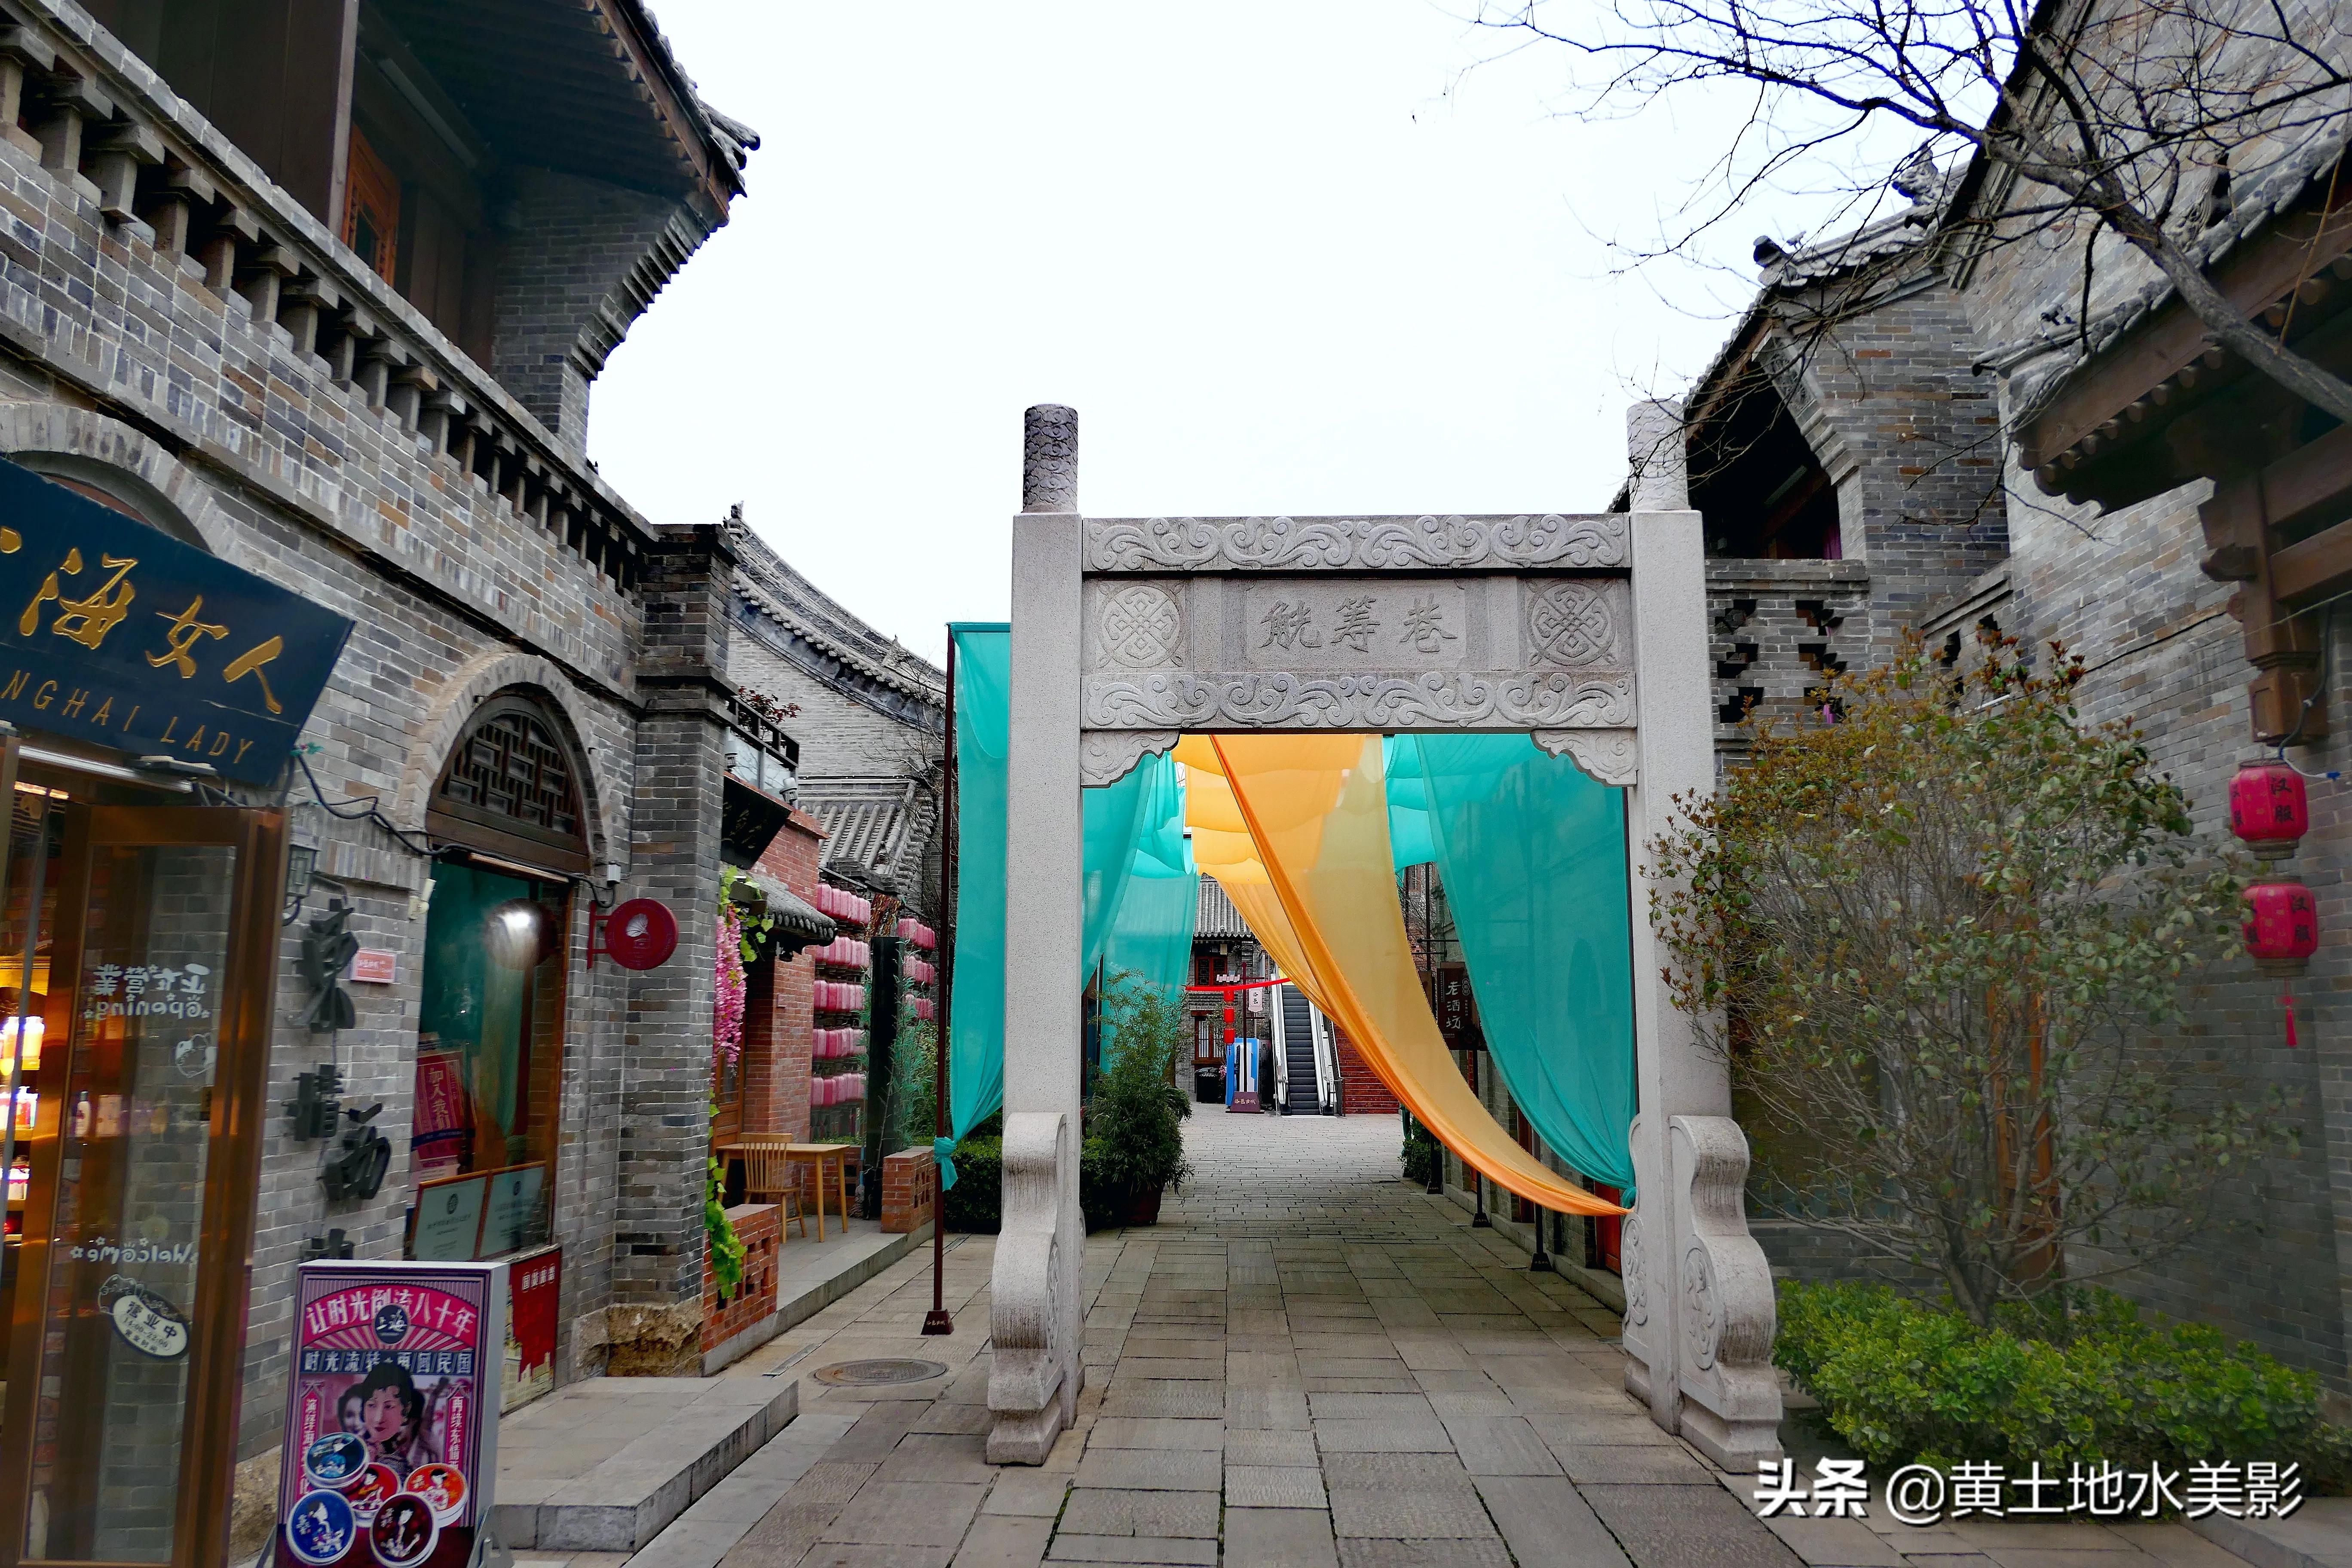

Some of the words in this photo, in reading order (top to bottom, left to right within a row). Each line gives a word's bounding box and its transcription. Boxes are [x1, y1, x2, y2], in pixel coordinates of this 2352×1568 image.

[0, 526, 284, 715] 海女人
[160, 717, 254, 764] LADY
[1445, 981, 1464, 1030] 老酒坊
[375, 1308, 408, 1332] 上海
